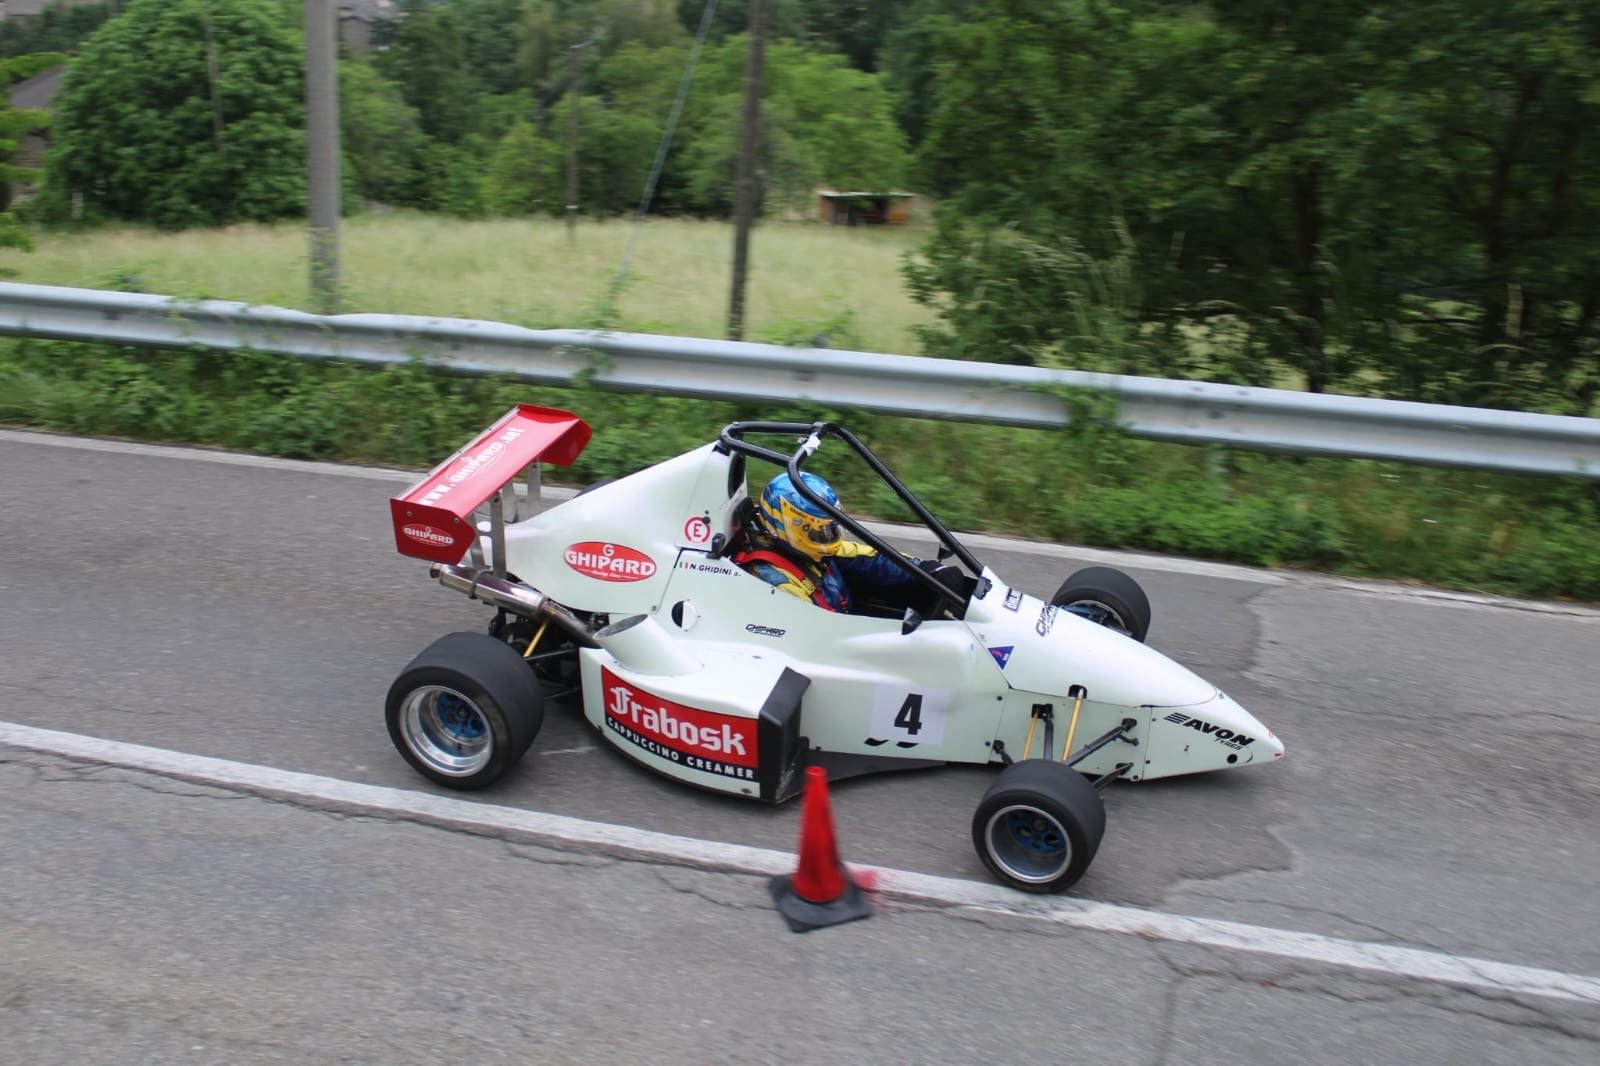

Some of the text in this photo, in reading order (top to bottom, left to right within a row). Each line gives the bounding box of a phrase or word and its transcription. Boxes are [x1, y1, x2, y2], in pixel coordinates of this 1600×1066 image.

[404, 527, 454, 544] GHIPARD
[693, 522, 702, 538] E
[603, 544, 615, 557] G
[565, 551, 656, 576] GHIPARD
[610, 686, 747, 756] Frabosk
[894, 693, 923, 735] 4
[1183, 719, 1256, 746] AVON
[1214, 738, 1243, 751] TYRES
[608, 717, 754, 779] CAPPUCCINO CREAMER
